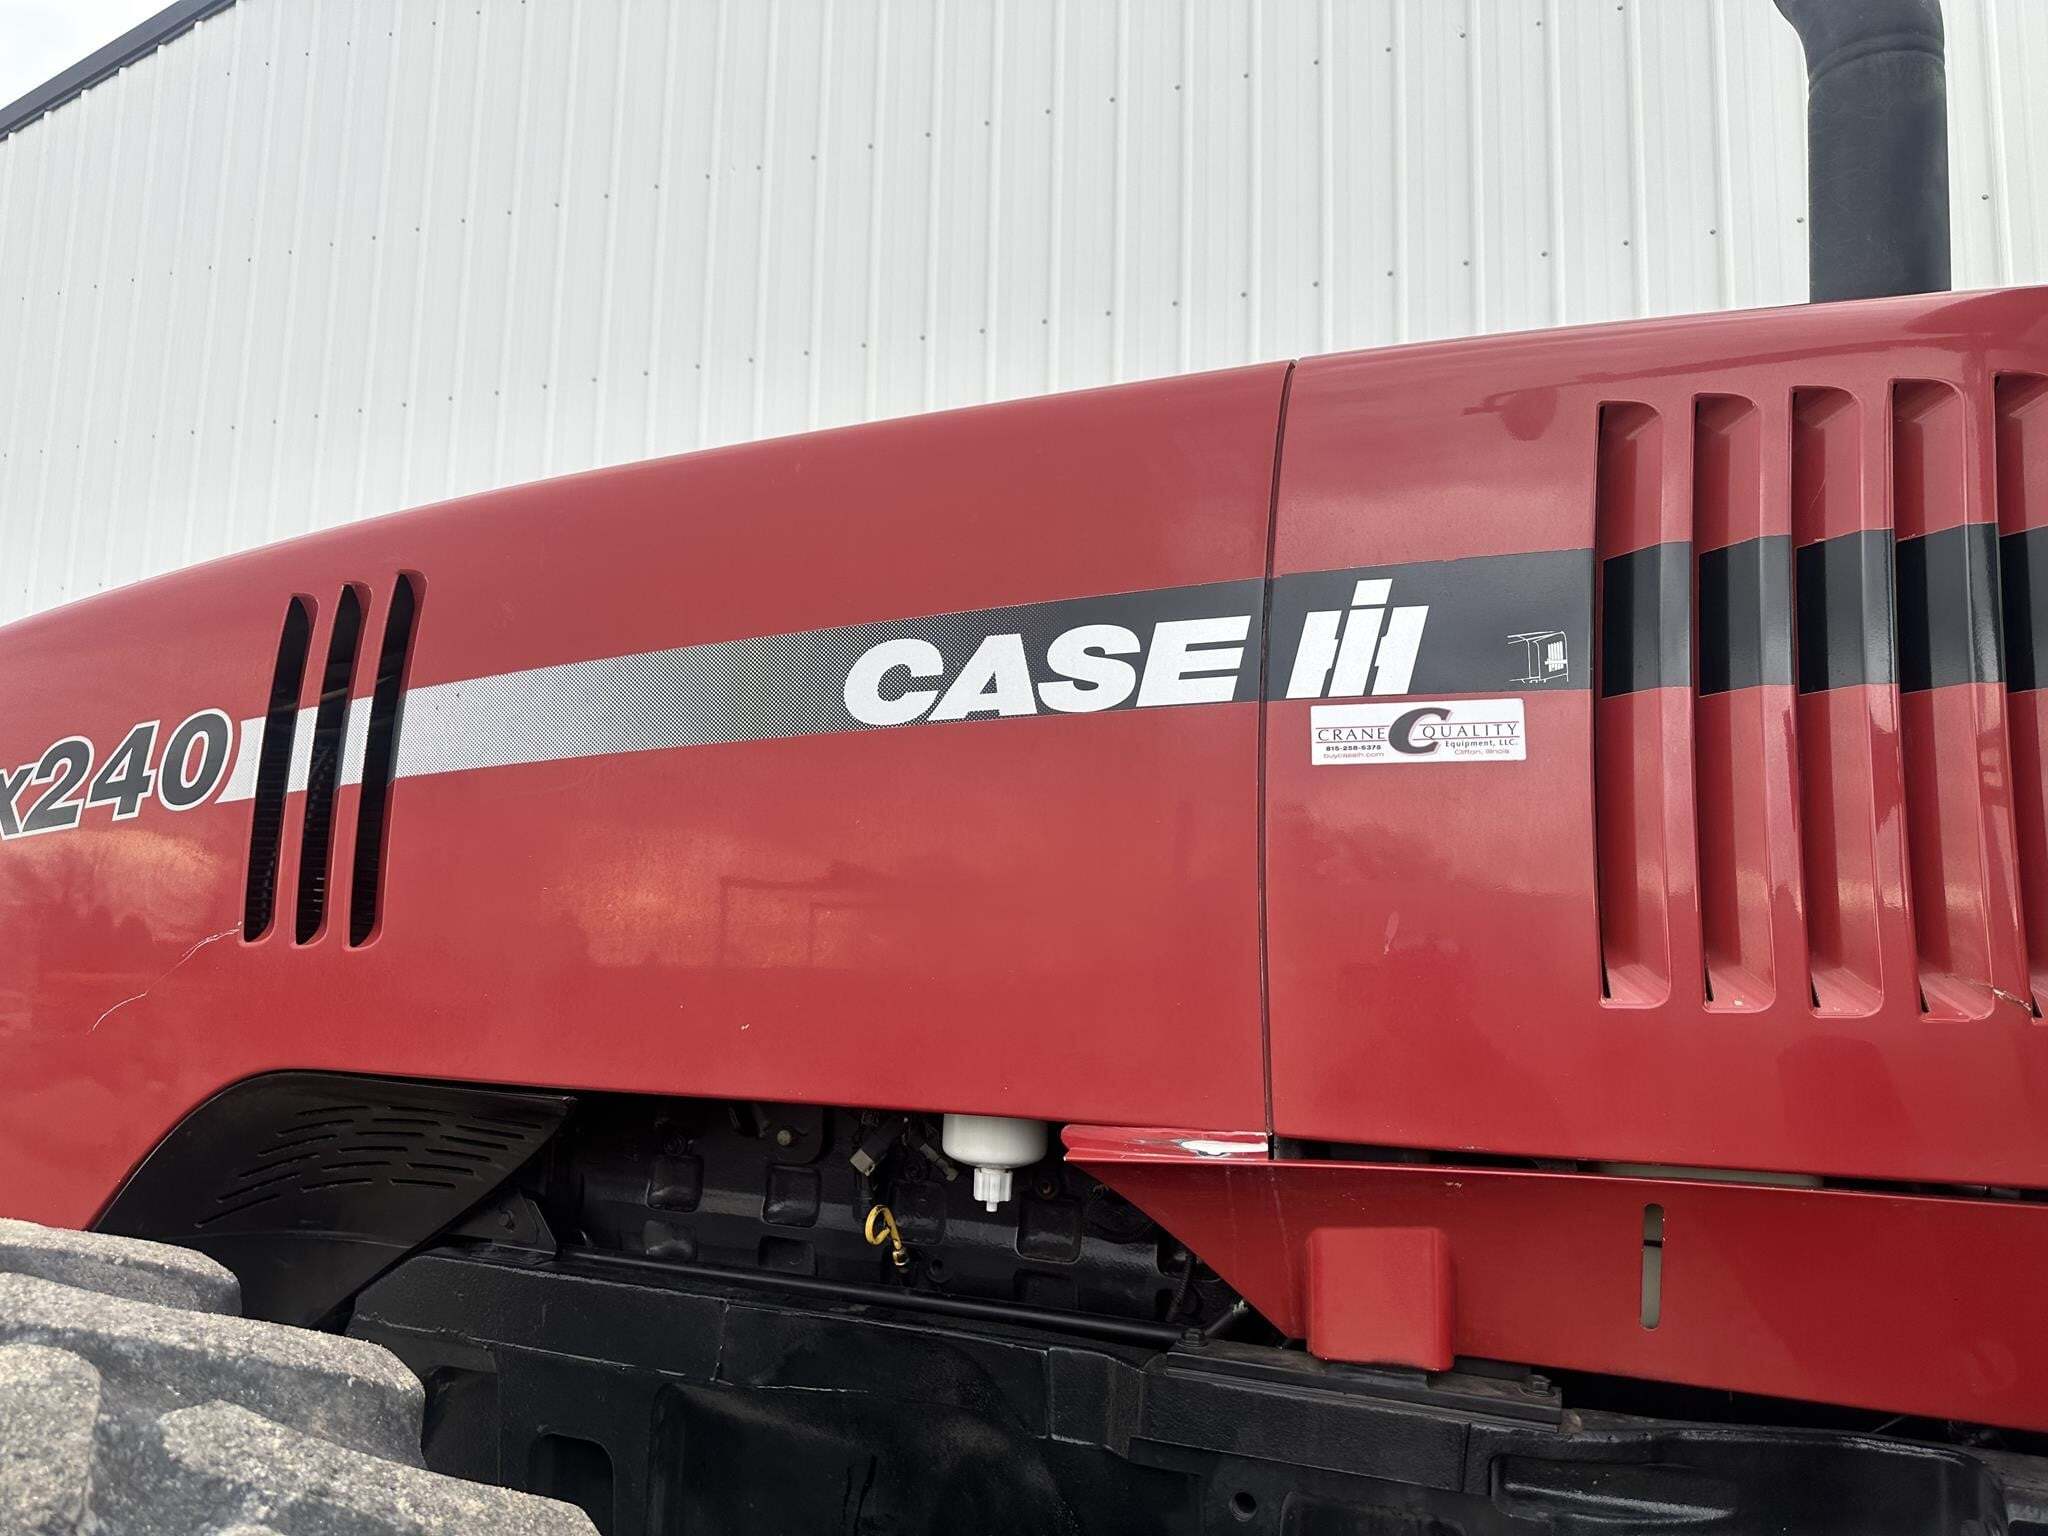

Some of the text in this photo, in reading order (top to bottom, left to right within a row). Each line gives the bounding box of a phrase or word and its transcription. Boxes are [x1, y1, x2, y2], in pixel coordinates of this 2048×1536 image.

[842, 614, 1252, 726] CASE
[1317, 727, 1386, 743] CRANE
[1422, 722, 1518, 741] QUALITY
